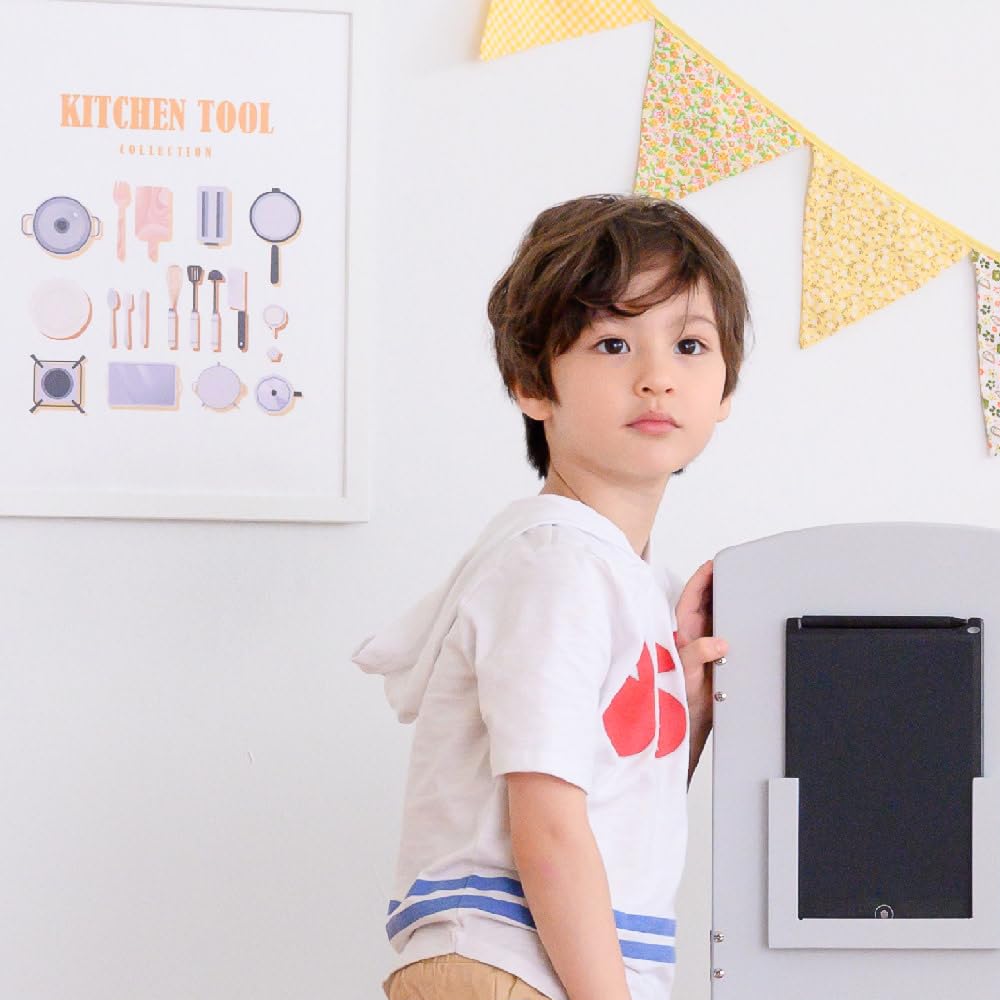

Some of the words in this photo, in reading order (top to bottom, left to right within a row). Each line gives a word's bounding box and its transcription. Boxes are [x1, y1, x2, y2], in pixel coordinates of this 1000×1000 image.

[59, 93, 186, 131] KITCHEN
[198, 99, 275, 134] TOOL
[119, 143, 212, 158] COLLECTION
